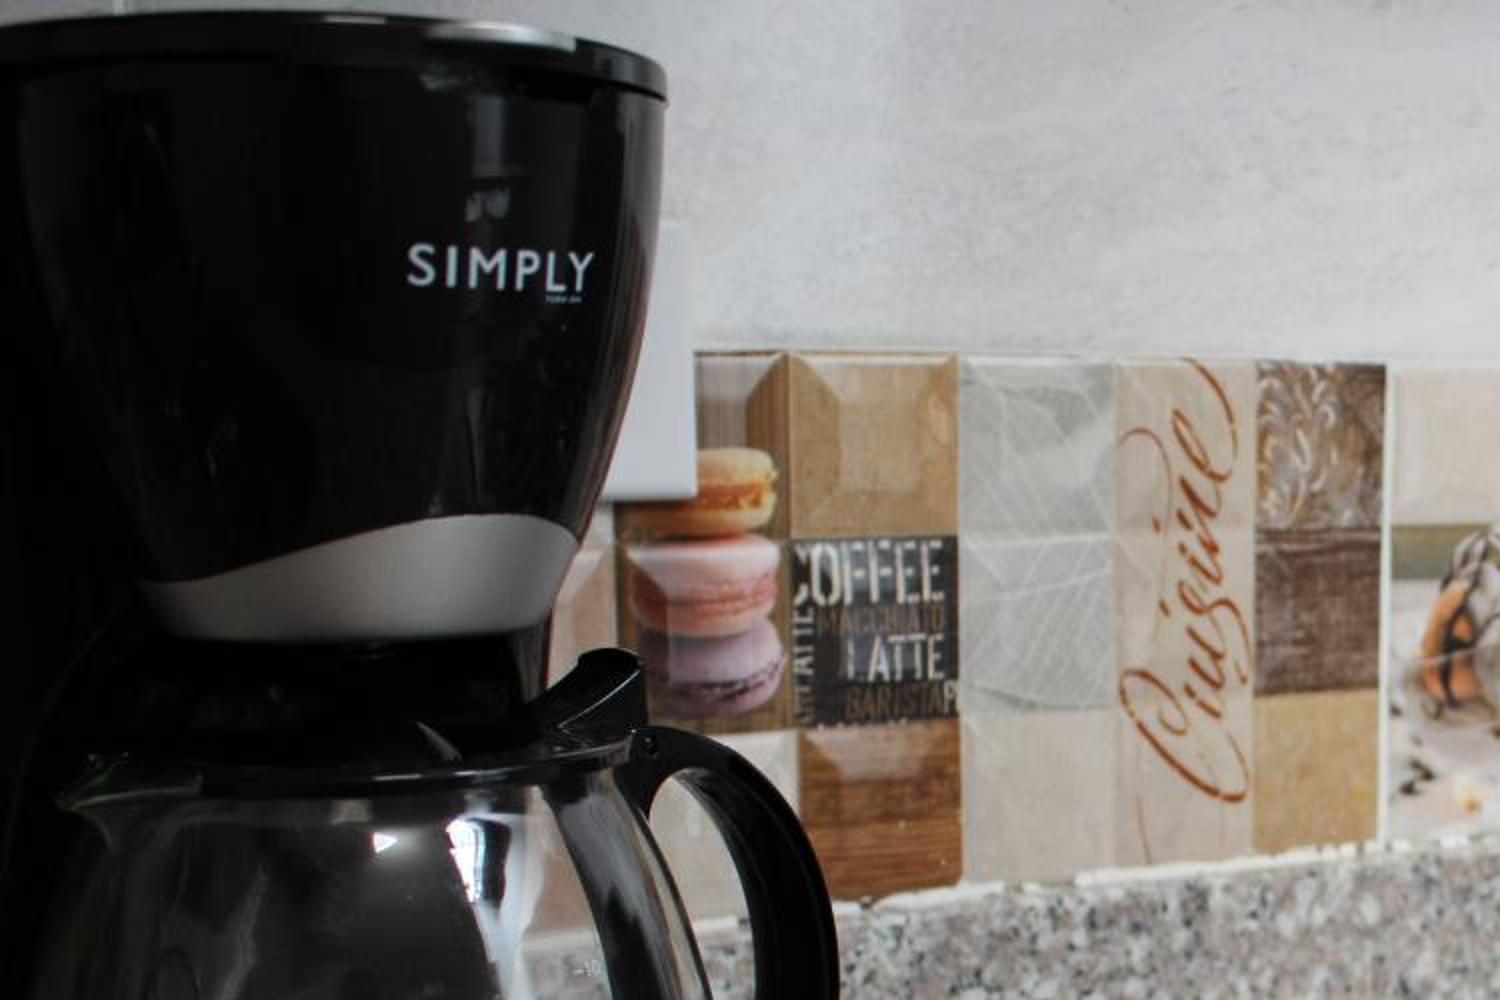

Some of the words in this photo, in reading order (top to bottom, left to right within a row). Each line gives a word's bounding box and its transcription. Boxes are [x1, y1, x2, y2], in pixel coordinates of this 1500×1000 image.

[407, 242, 594, 293] SIMPLY
[1118, 356, 1250, 803] Cuisine
[845, 632, 945, 682] LATTE
